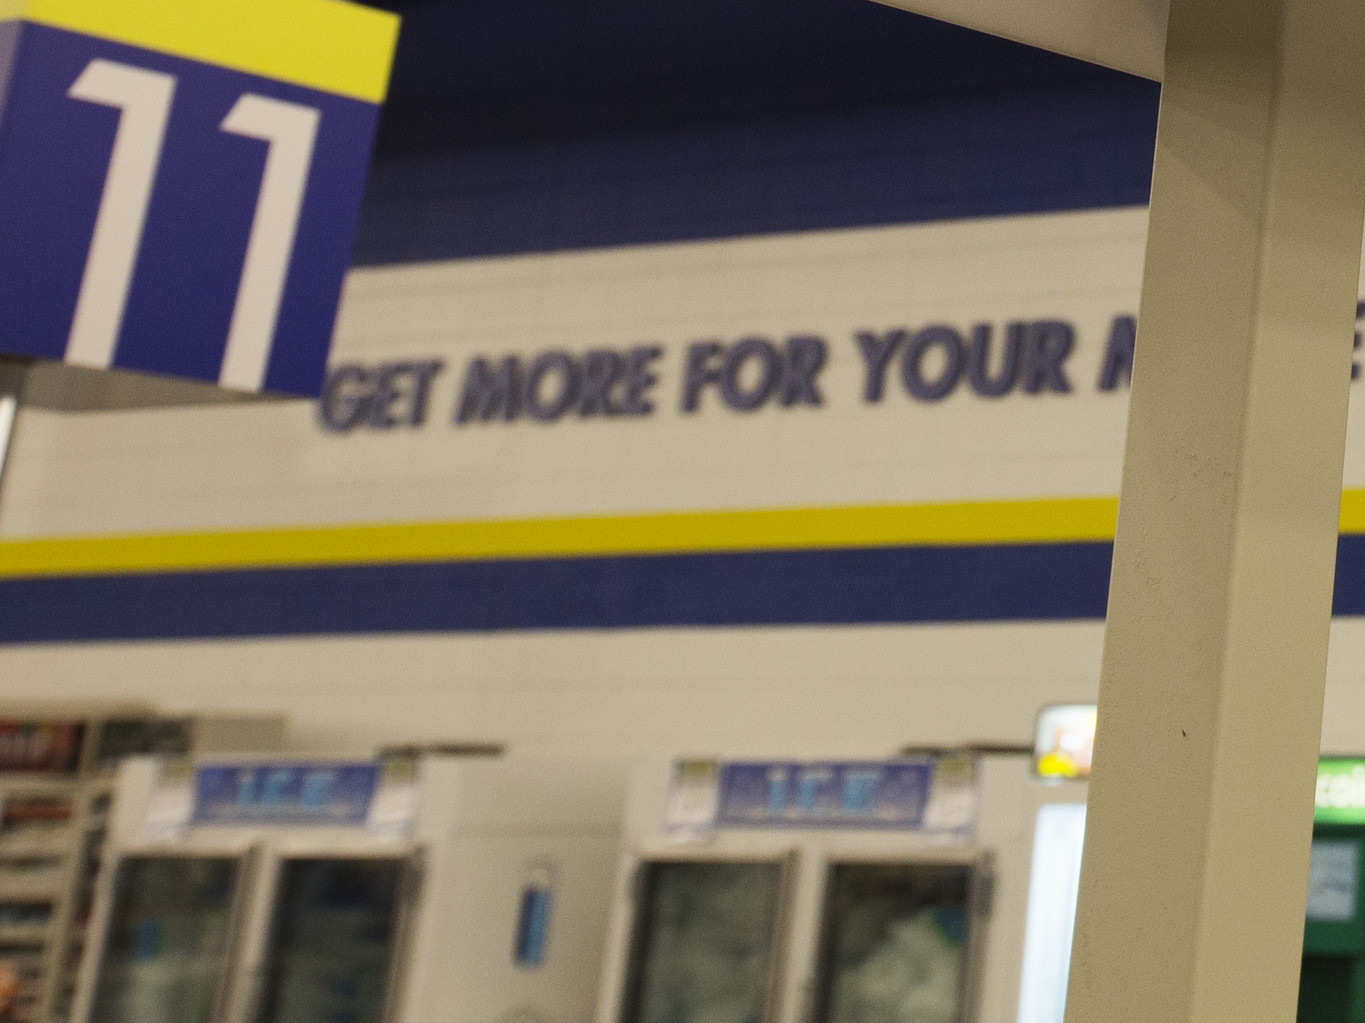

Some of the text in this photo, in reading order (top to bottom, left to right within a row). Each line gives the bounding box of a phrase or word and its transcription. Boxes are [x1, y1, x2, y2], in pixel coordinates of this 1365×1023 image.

[64, 58, 321, 393] 11
[320, 358, 445, 435] GET
[454, 345, 663, 425] MORE
[681, 335, 827, 413] FOR
[855, 318, 1078, 403] YOUR
